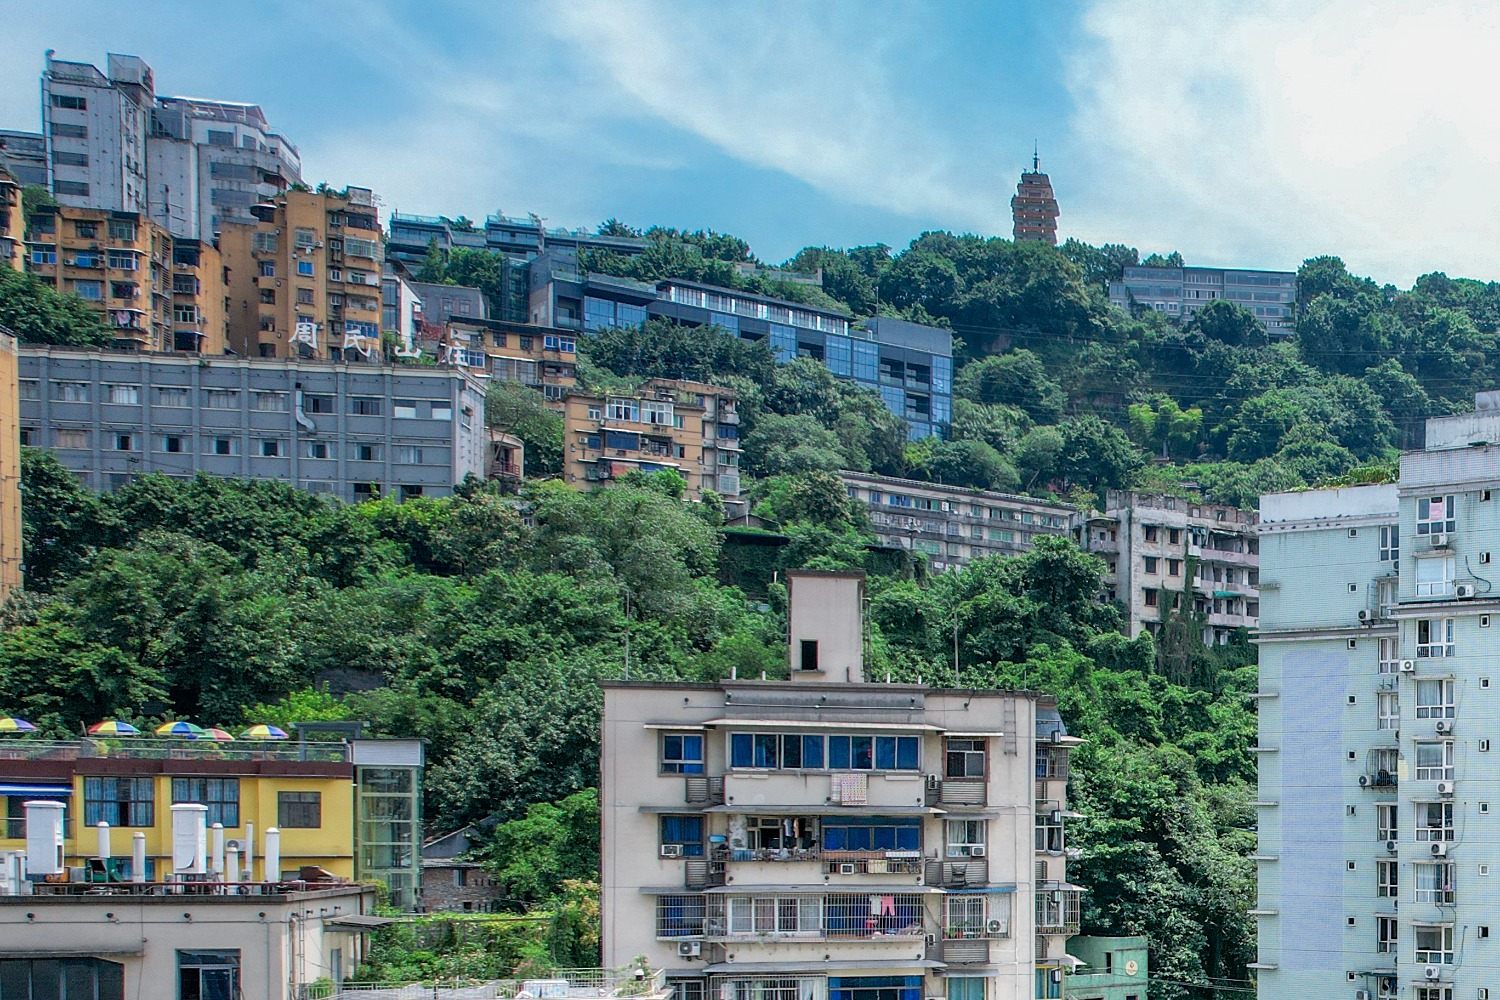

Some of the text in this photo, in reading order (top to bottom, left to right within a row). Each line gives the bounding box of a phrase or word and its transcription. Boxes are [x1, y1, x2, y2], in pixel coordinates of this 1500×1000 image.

[288, 322, 469, 366] 周氏山庄
[524, 731, 631, 803] 娃哈哈
